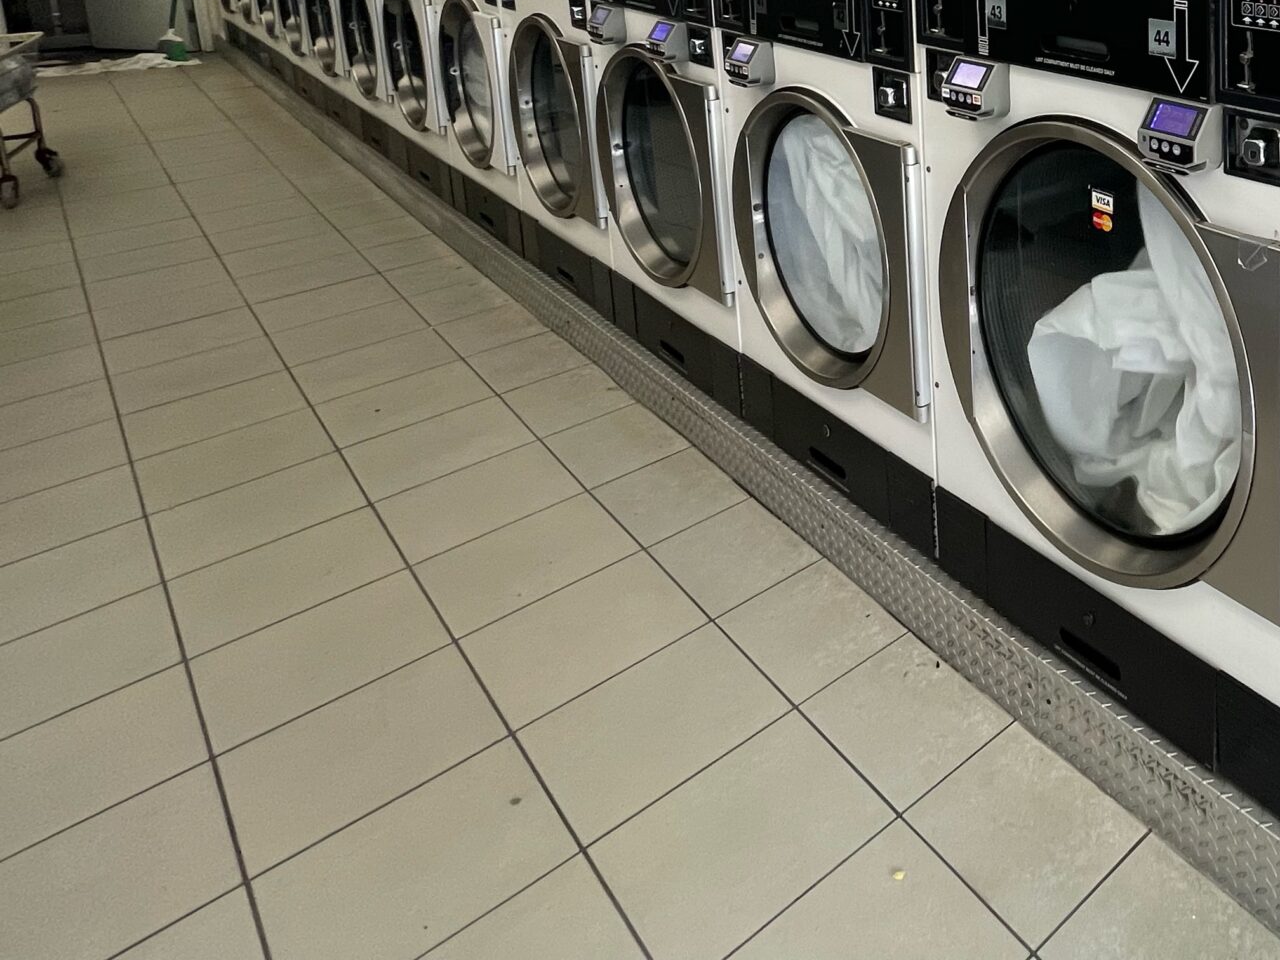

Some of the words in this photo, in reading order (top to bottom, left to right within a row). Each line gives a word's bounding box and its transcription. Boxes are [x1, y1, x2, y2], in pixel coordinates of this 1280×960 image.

[990, 4, 1002, 20] 43
[1153, 29, 1170, 47] 44
[1095, 194, 1111, 208] VISA
